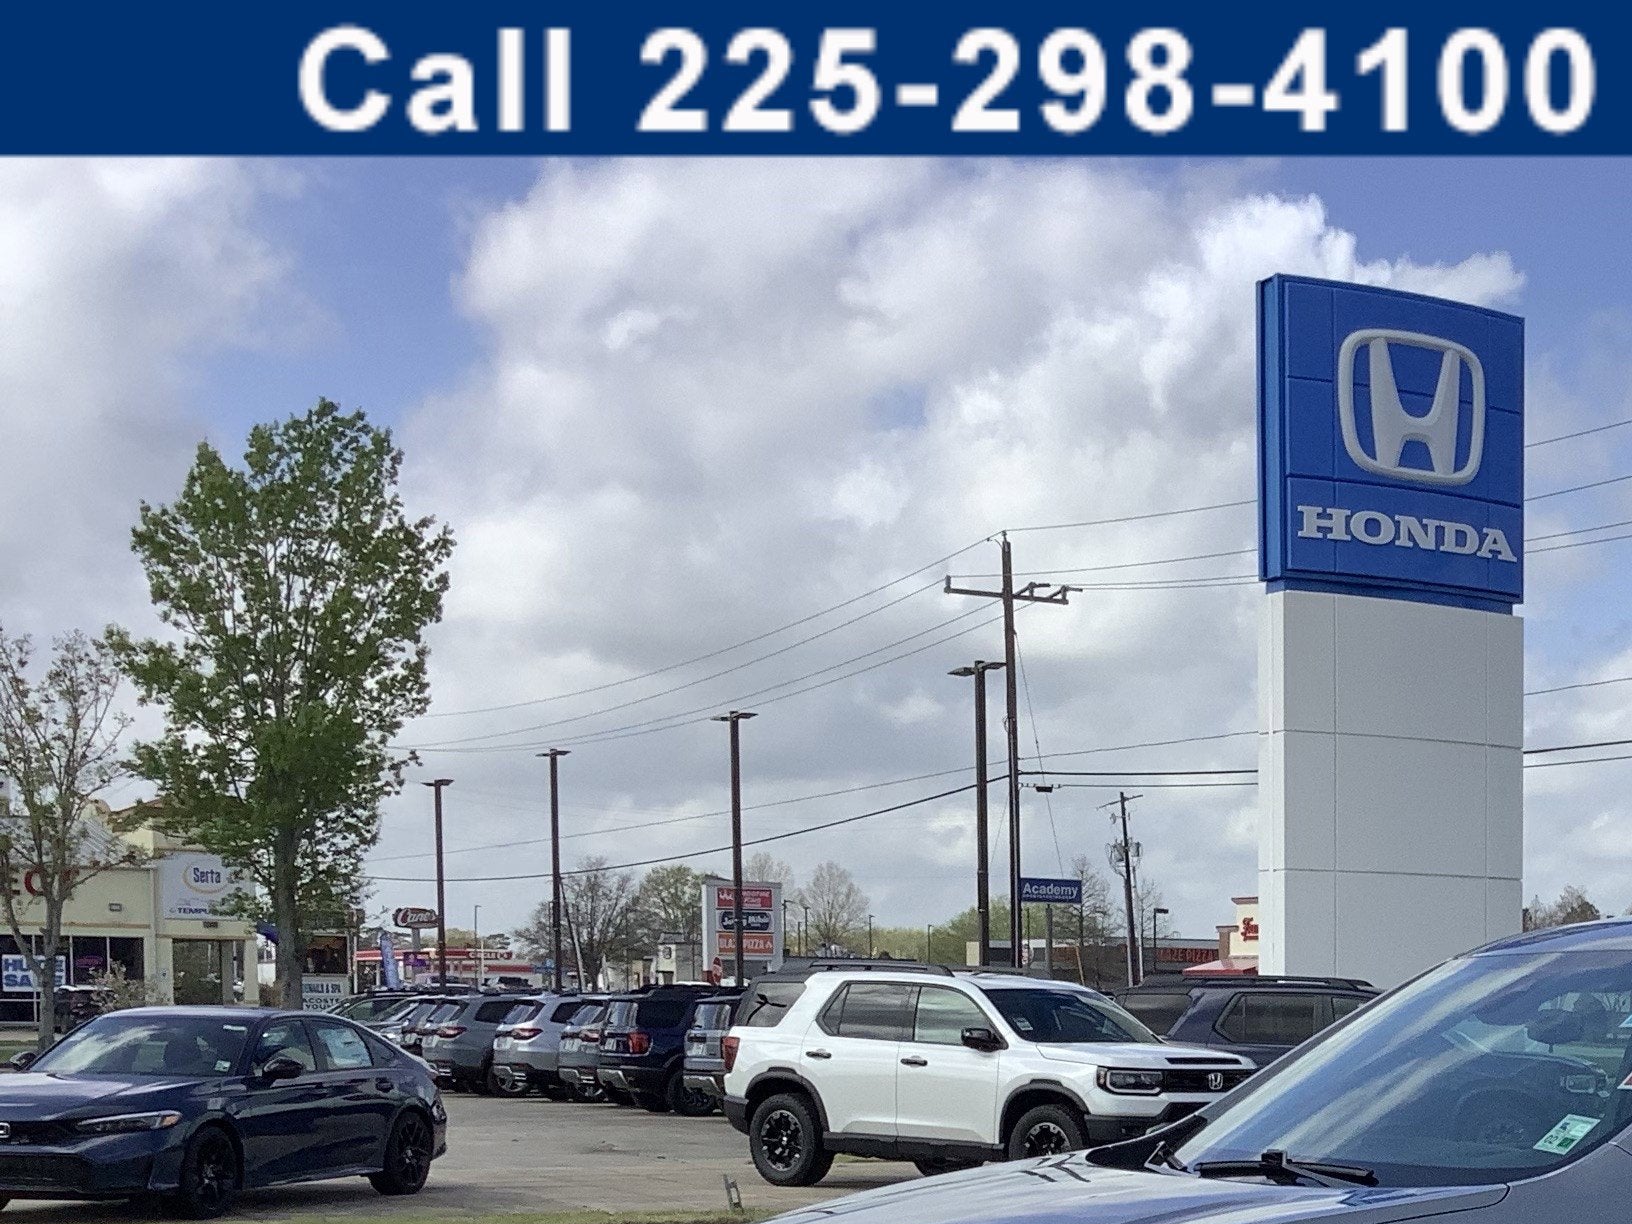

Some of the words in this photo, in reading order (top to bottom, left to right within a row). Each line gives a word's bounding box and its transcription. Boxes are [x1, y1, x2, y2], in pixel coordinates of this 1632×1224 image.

[1297, 505, 1518, 563] HONDA
[193, 867, 221, 884] Serta
[1023, 883, 1078, 899] Academy
[4, 973, 64, 987] SAE
